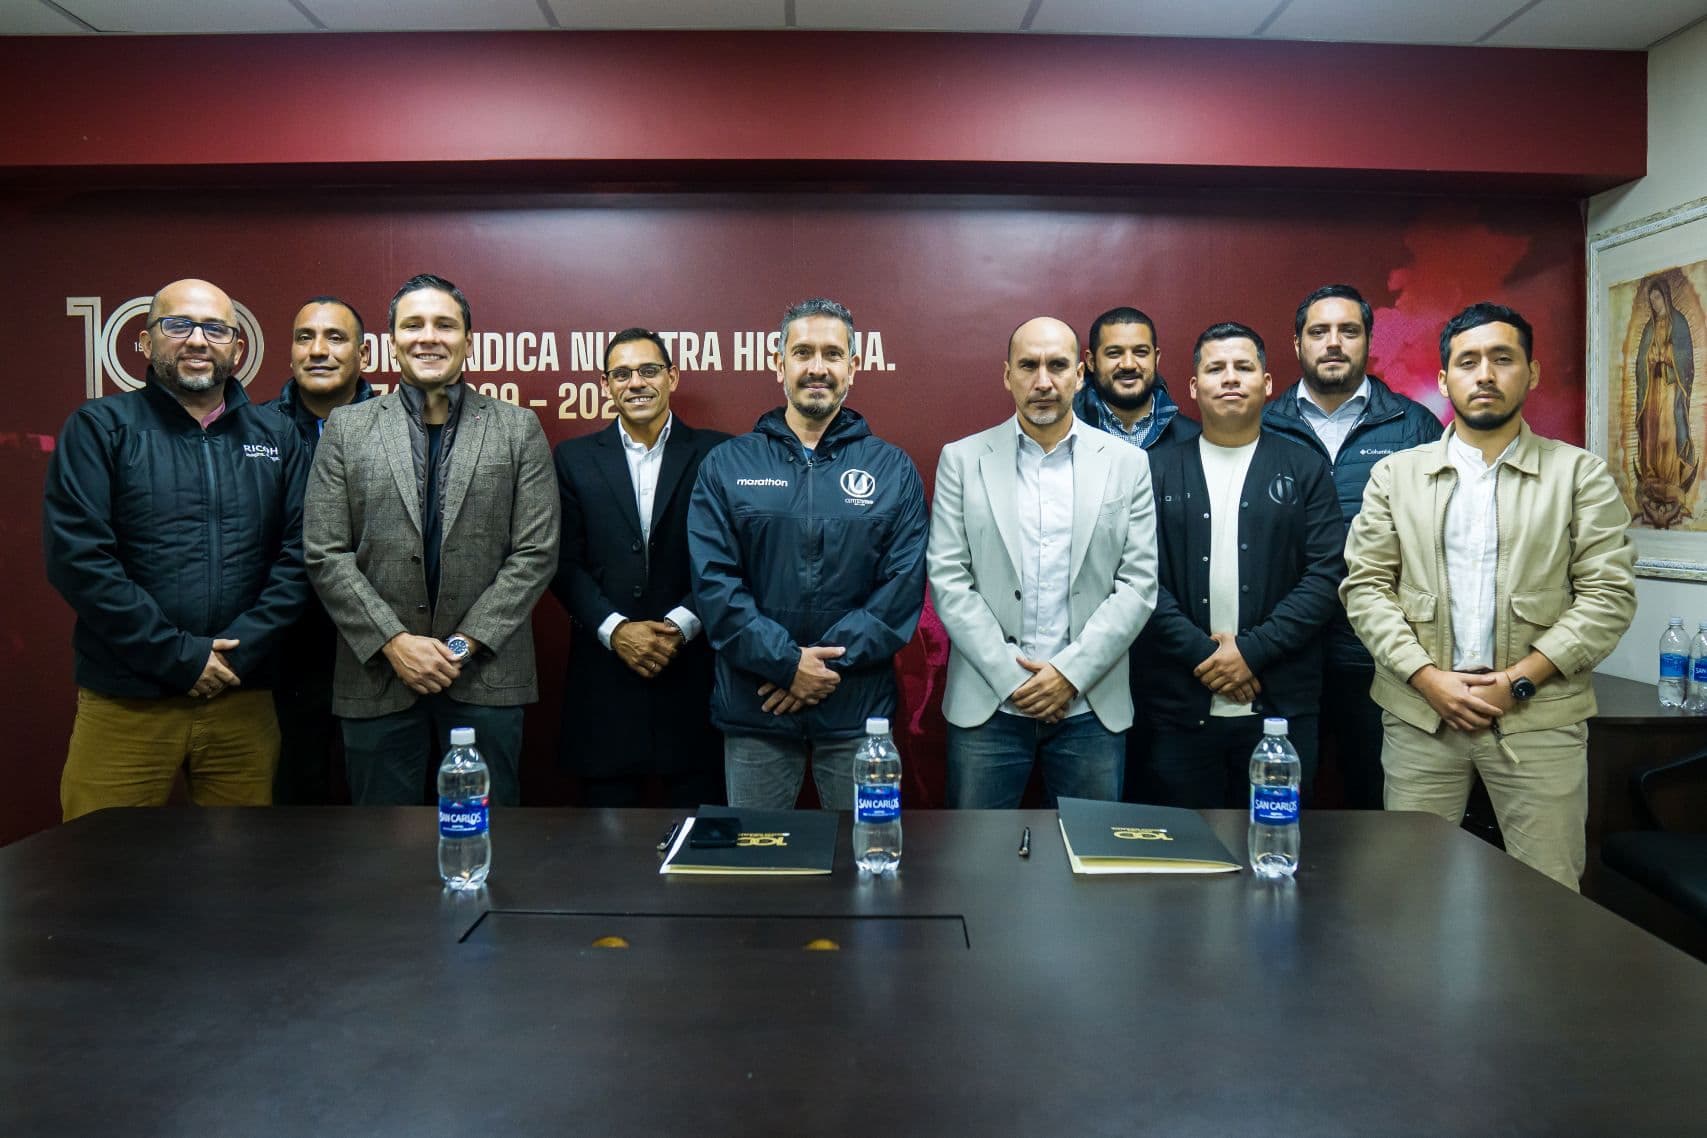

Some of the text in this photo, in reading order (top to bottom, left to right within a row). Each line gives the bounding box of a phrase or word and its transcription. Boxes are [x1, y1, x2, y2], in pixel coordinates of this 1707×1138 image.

[571, 330, 723, 371] NUTRA
[734, 331, 897, 371] HISIA.
[558, 382, 621, 420] 202
[736, 478, 789, 487] marathon
[858, 797, 899, 810] SAN CARLOS
[1255, 799, 1298, 812] SAN CARLOS
[451, 812, 482, 825] CARLOS
